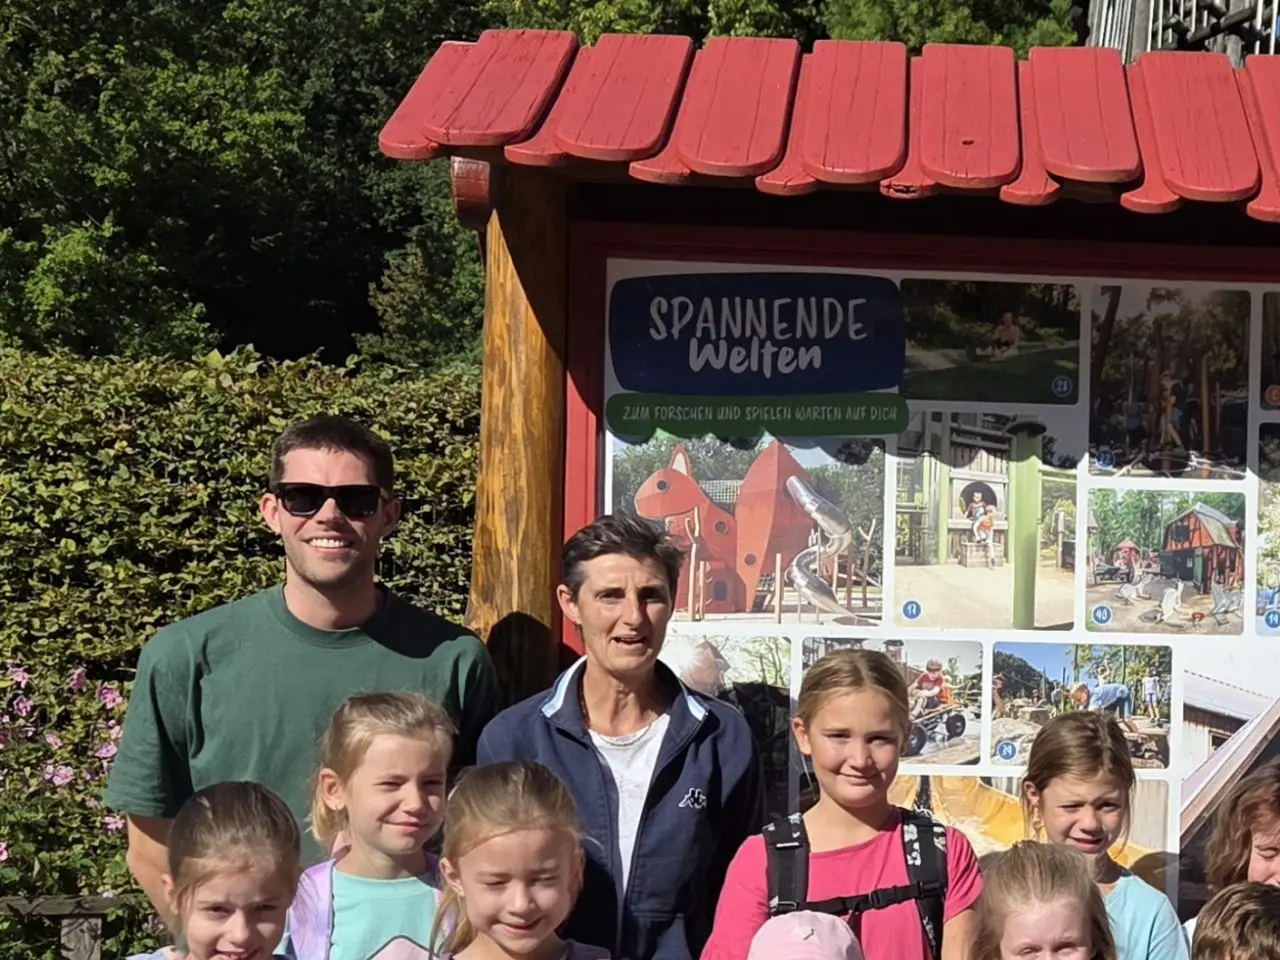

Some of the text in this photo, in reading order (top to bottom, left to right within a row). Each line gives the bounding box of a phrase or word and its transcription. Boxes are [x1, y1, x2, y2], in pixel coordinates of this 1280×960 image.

[650, 296, 867, 340] SPANNENDE
[689, 336, 822, 378] Welten
[622, 406, 898, 421] ZUM FORSCHEN UND SPIELEN WARTEN AUF DICH
